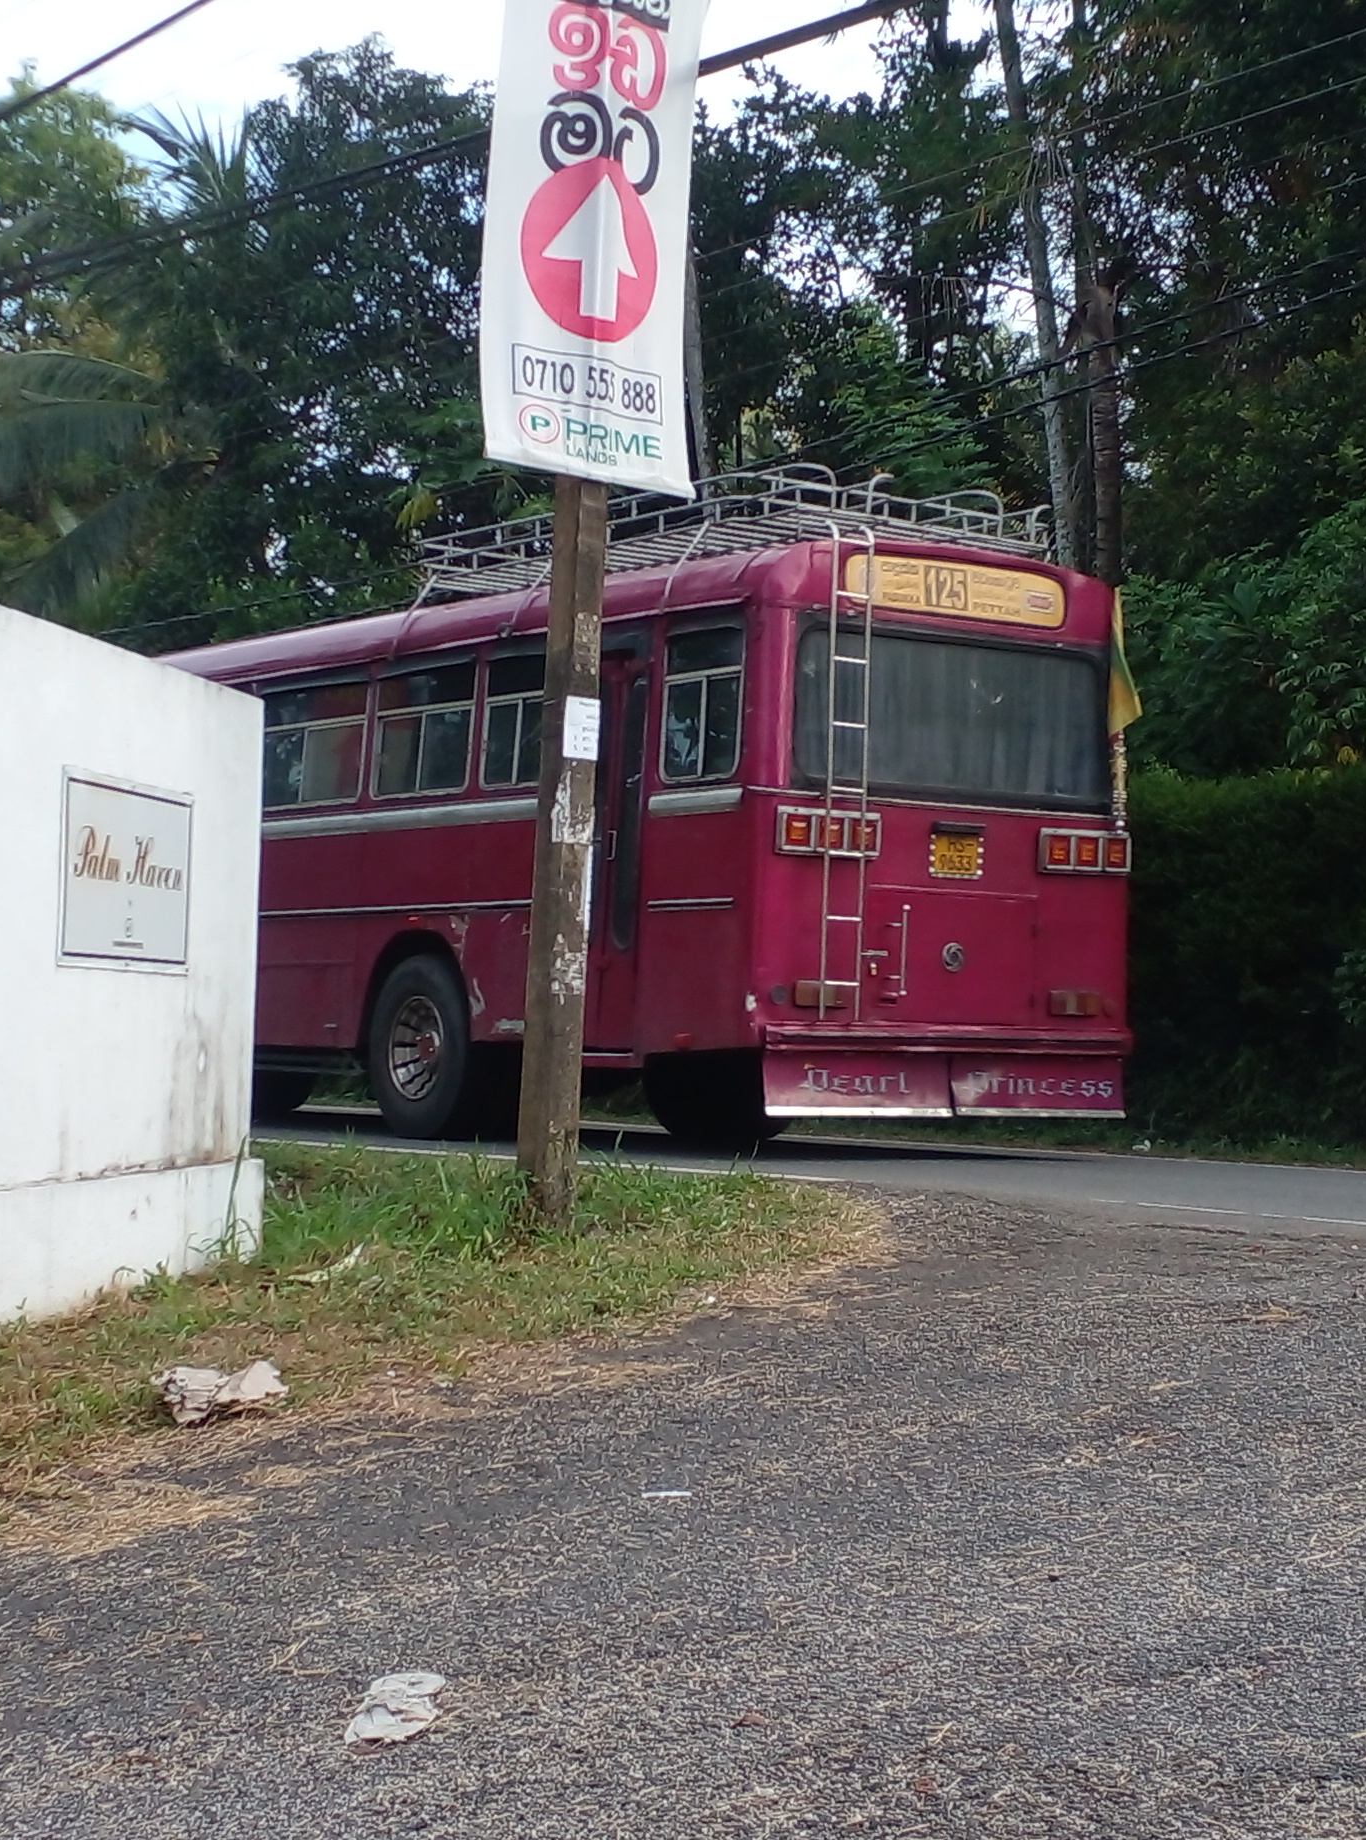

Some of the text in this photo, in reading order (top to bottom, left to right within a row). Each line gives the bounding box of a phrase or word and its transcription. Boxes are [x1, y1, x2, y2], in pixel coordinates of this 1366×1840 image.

[522, 355, 575, 394] 0710
[621, 378, 656, 414] 888
[565, 417, 663, 461] PRIME
[566, 444, 618, 466] LANDS
[925, 565, 969, 611] 125
[973, 601, 1021, 617] PETTAH
[73, 824, 183, 891] Palm Haven
[798, 1068, 1116, 1099] Pearl Princess
